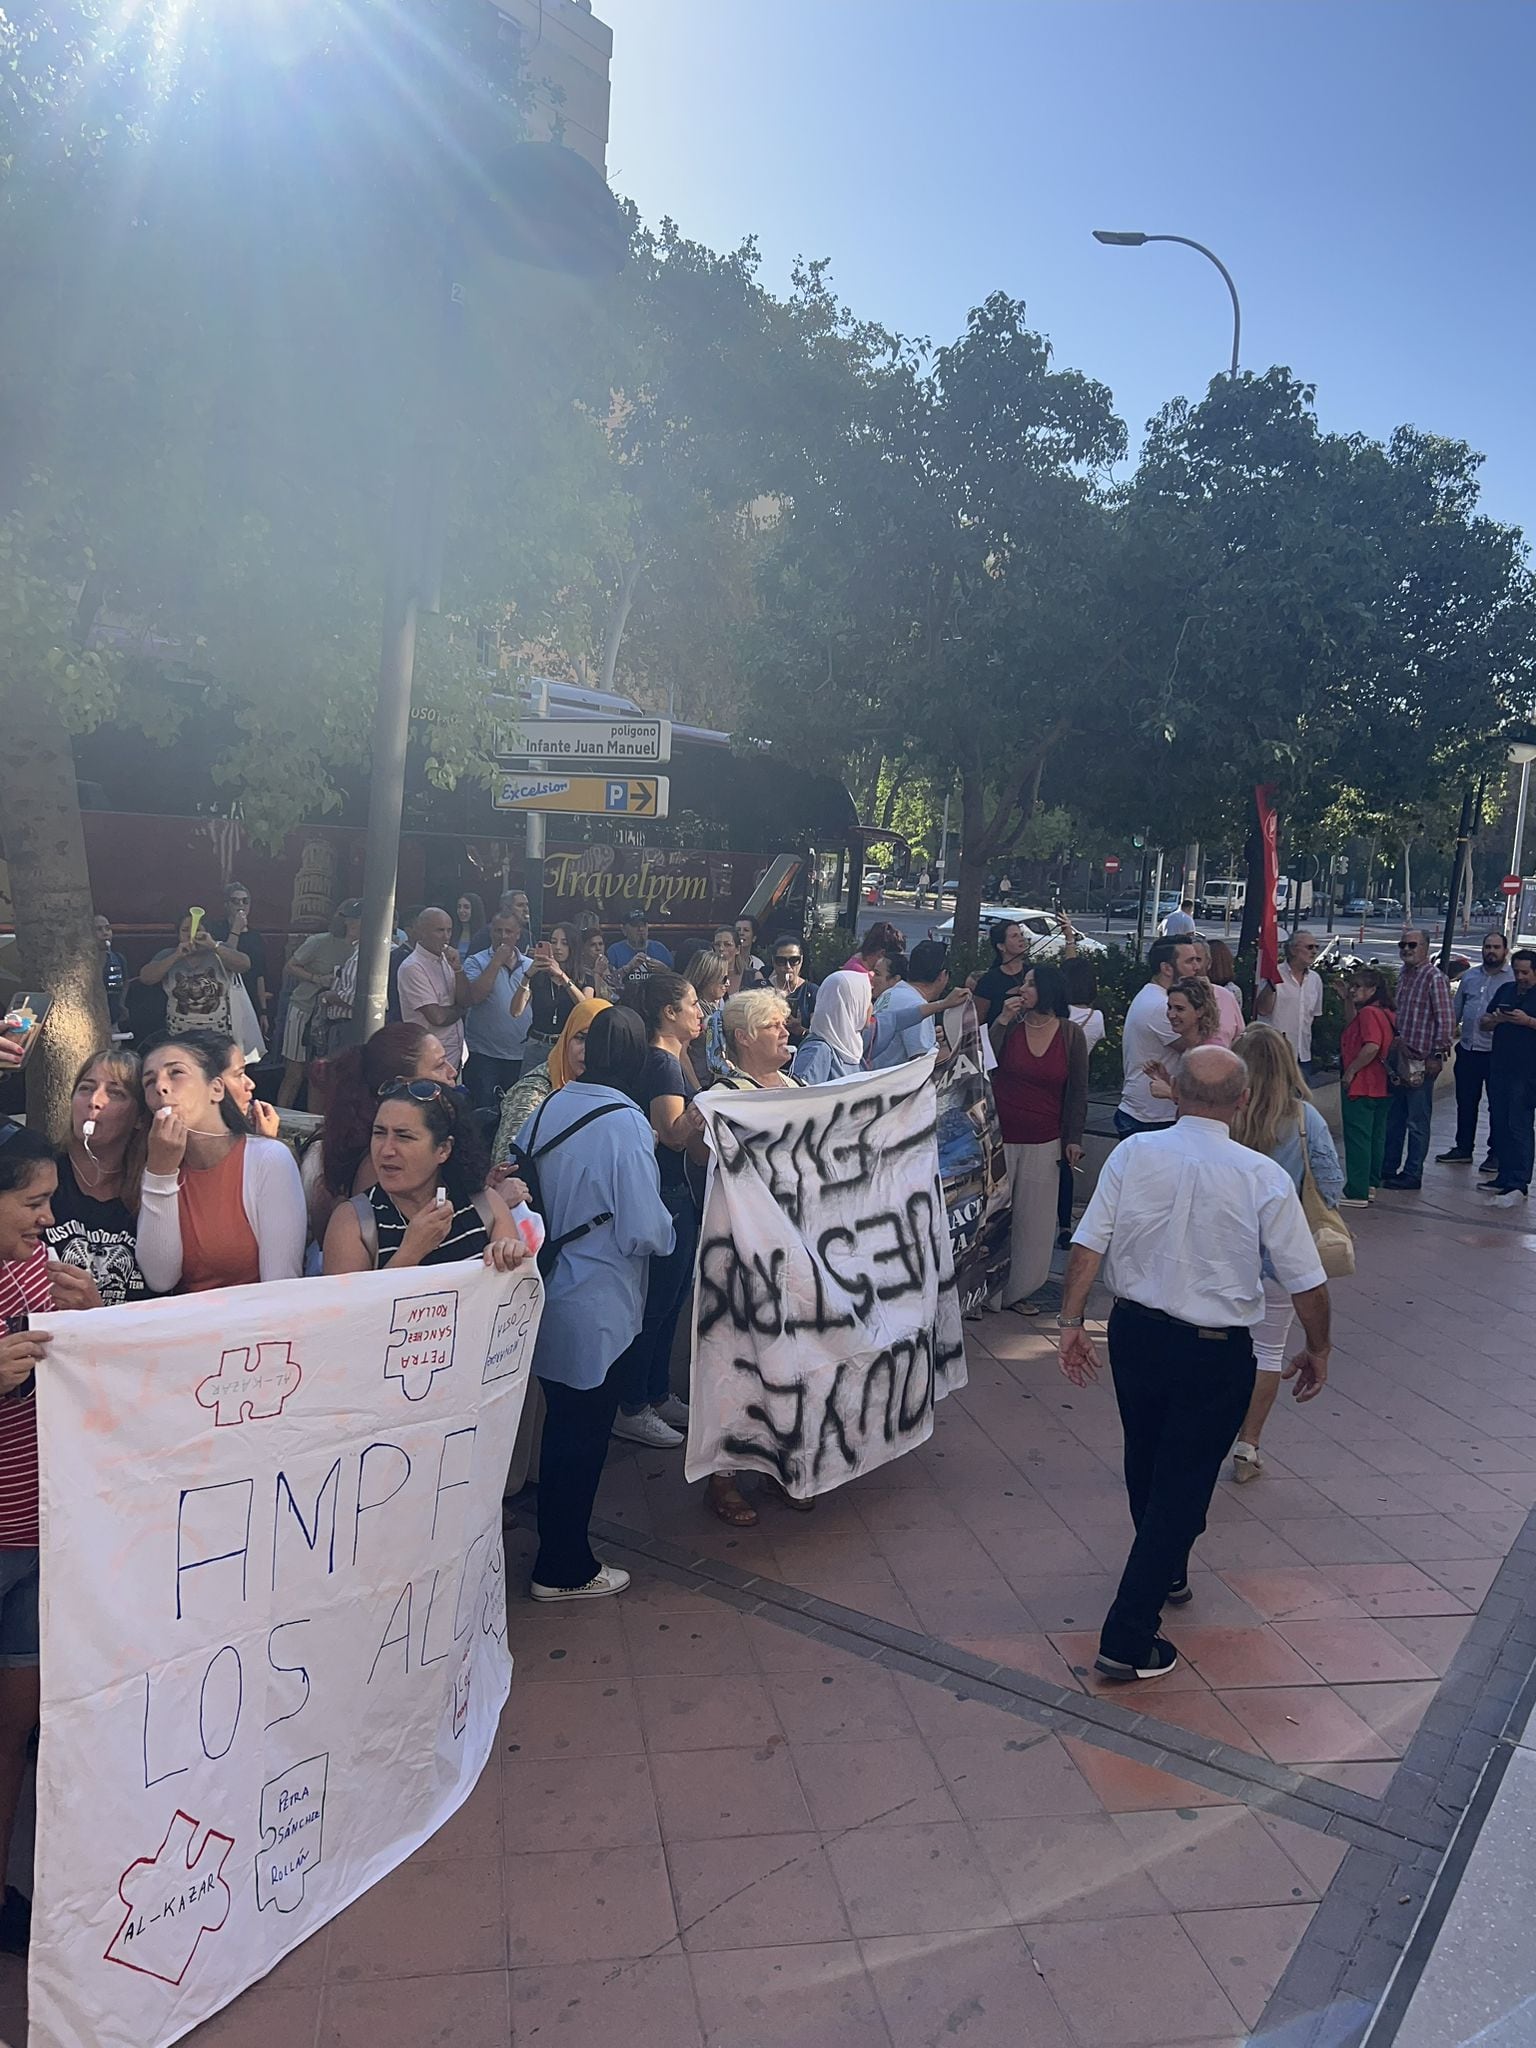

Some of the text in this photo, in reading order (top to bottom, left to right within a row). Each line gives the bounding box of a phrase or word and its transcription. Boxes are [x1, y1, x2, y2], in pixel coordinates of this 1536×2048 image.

[611, 724, 656, 739] polígono
[526, 739, 656, 756] Infante Juan Manuel
[501, 781, 624, 807] Excelsior P
[543, 852, 708, 915] Travelpym
[401, 1349, 446, 1369] PETRA
[144, 1619, 312, 1789] LOS
[123, 1873, 216, 1945] AL-KAZAR
